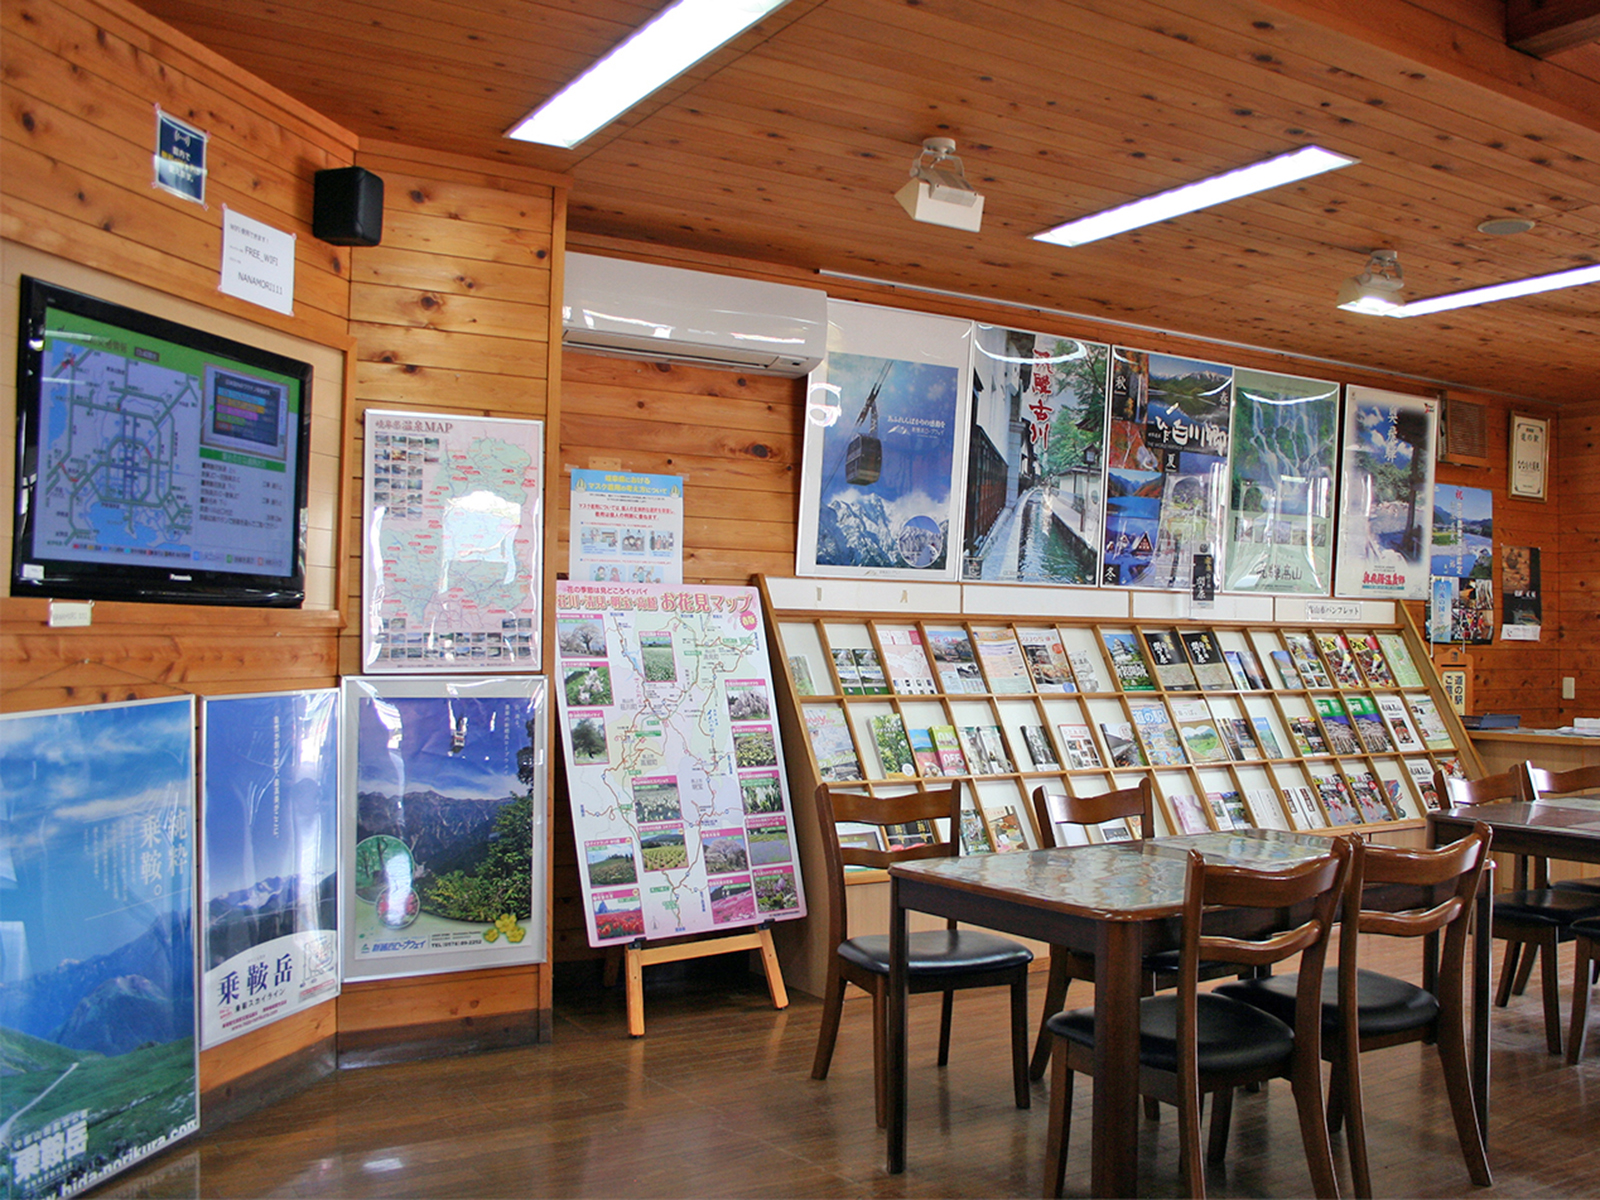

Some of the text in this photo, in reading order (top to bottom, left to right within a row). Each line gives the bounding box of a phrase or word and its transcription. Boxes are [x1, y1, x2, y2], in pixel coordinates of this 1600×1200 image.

[245, 246, 279, 267] FREE_WIFI
[1115, 375, 1127, 390] 秋
[1172, 418, 1227, 457] 白川郷
[567, 585, 648, 595] 花の季節は見どころイッパイ
[660, 592, 753, 614] お花見マップ
[1454, 675, 1463, 706] 道の駅
[140, 814, 163, 896] 乗鞍。
[217, 953, 293, 1007] 乗鞍岳
[10, 1119, 89, 1185] 乗鞍岳
